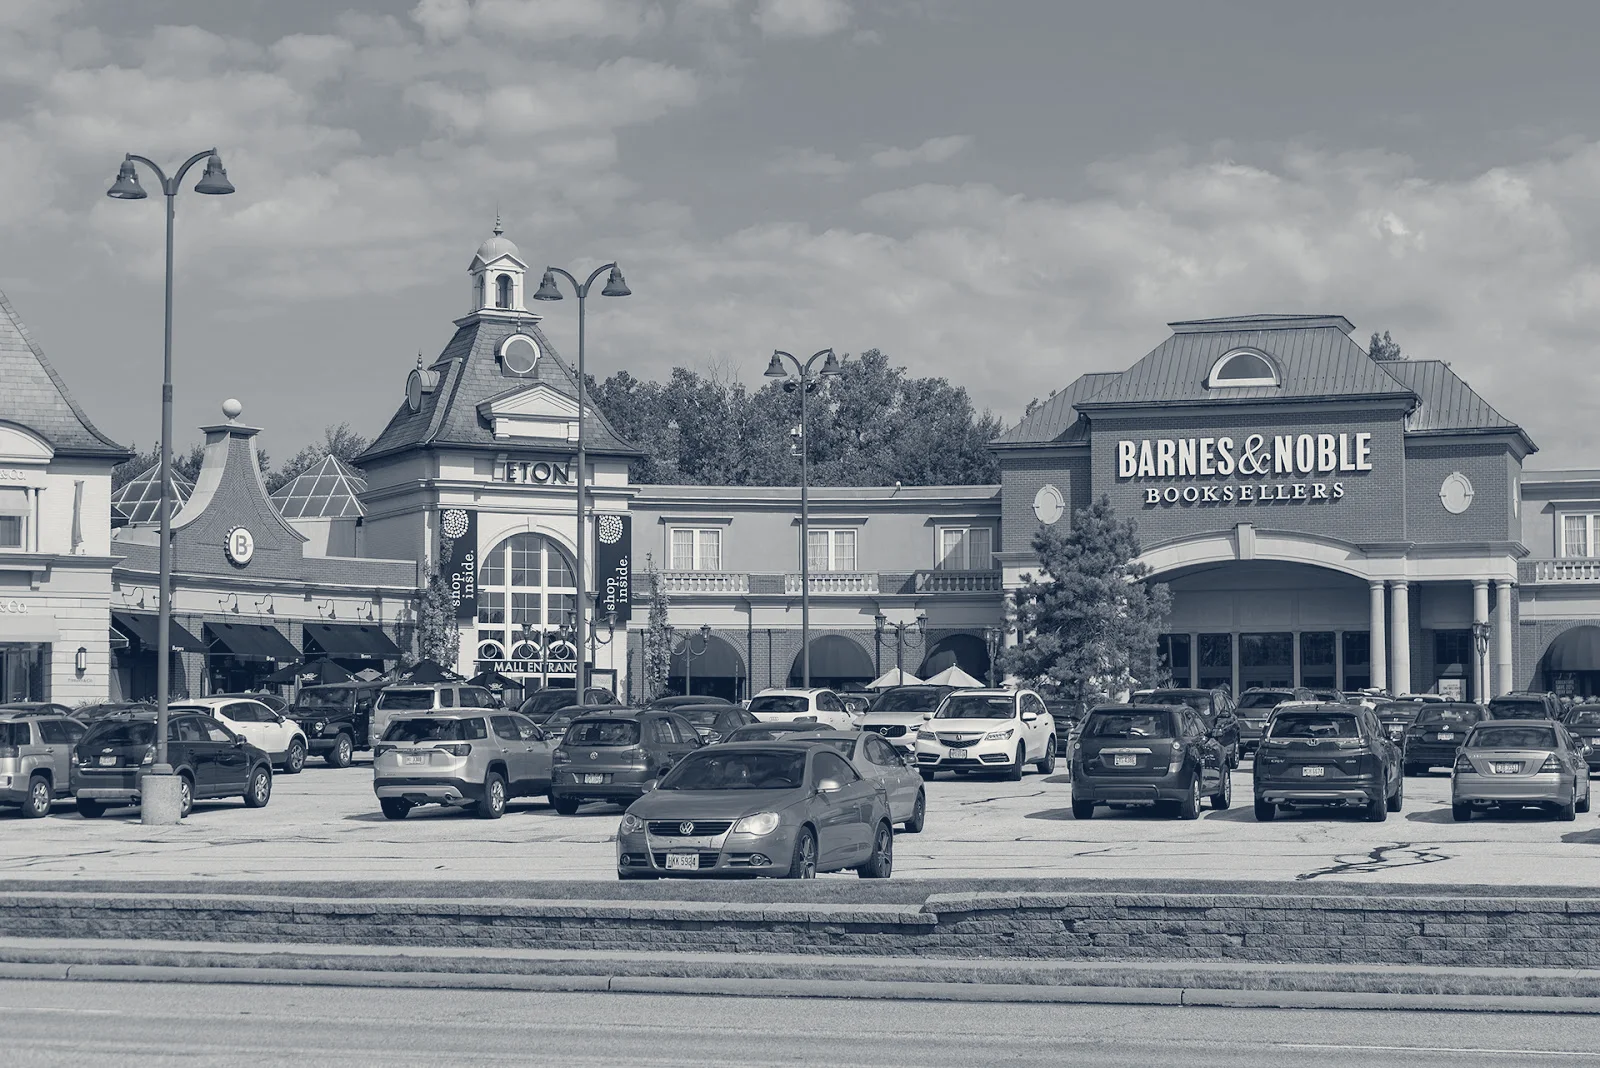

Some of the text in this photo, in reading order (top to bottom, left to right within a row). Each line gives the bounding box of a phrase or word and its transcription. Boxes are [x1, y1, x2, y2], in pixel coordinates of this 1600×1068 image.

[506, 461, 569, 483] ETON
[1118, 432, 1373, 478] BARNES & NOBLE
[1145, 481, 1344, 504] BOOKSELLERS
[451, 572, 465, 607] shop
[461, 550, 474, 599] inside.
[615, 555, 628, 603] inside.
[603, 577, 619, 611] shop
[494, 662, 524, 672] MALL
